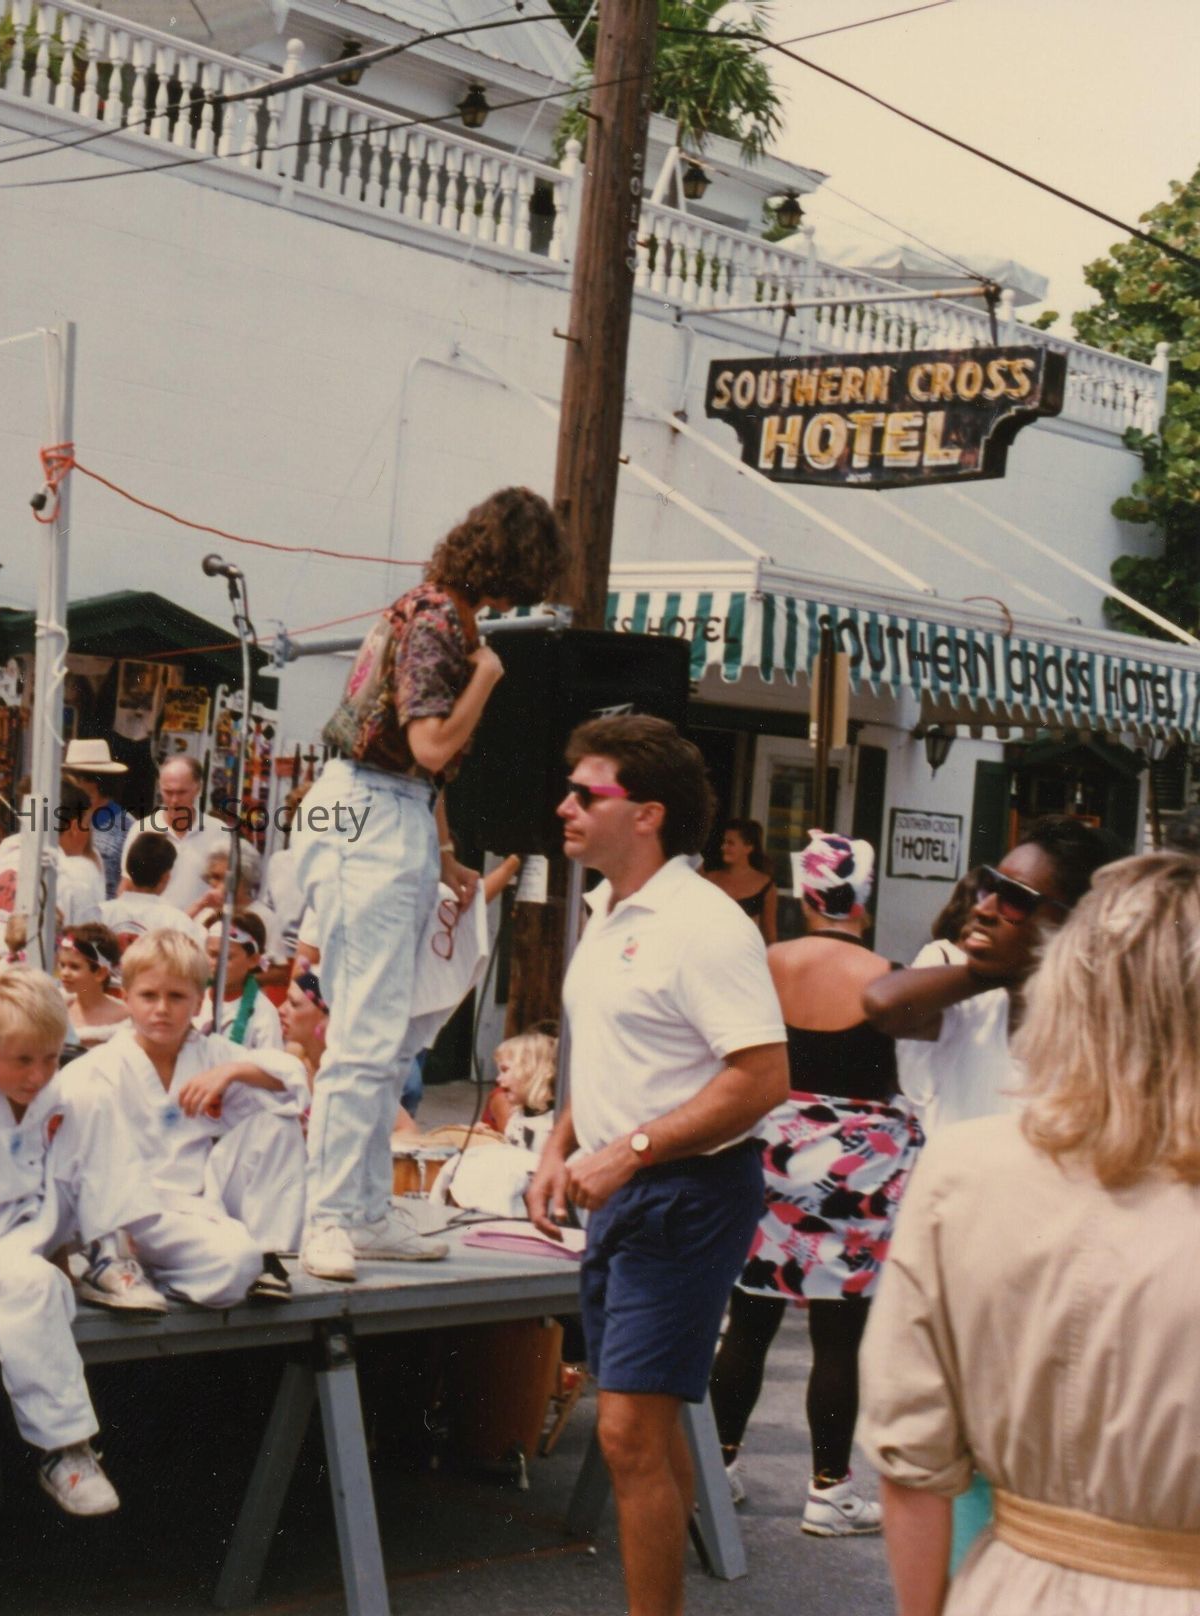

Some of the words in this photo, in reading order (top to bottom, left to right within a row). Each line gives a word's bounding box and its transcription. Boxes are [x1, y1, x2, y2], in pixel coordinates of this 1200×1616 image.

[711, 365, 892, 410] SOUTHERN
[907, 358, 1036, 402] CROSS
[758, 411, 962, 470] HOTEL
[647, 615, 739, 644] HOTEL
[1006, 650, 1093, 706] CROSS
[1103, 664, 1177, 720] HOTEL
[901, 835, 949, 863] HOTEL
